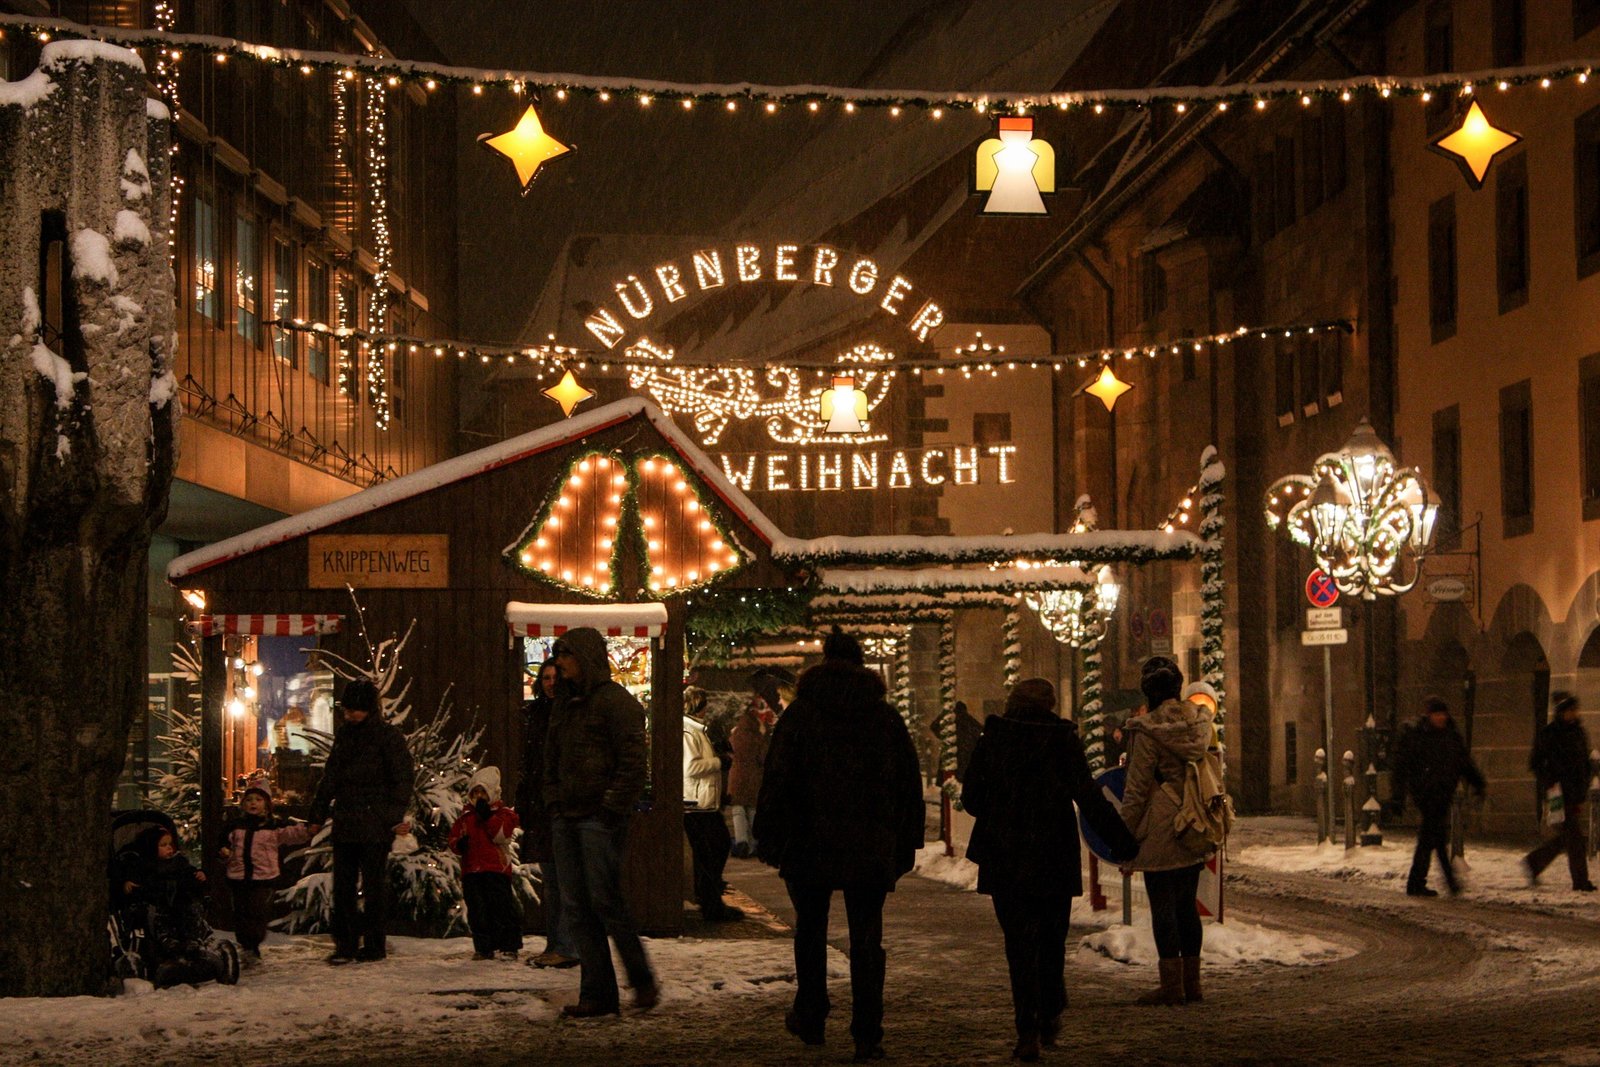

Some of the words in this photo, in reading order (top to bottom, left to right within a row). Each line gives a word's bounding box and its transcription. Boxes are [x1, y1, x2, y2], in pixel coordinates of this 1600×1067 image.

[585, 245, 944, 347] NÜRNBERGER
[721, 446, 1016, 491] WEIHNACHT
[323, 550, 431, 573] KRIPPENWEG
